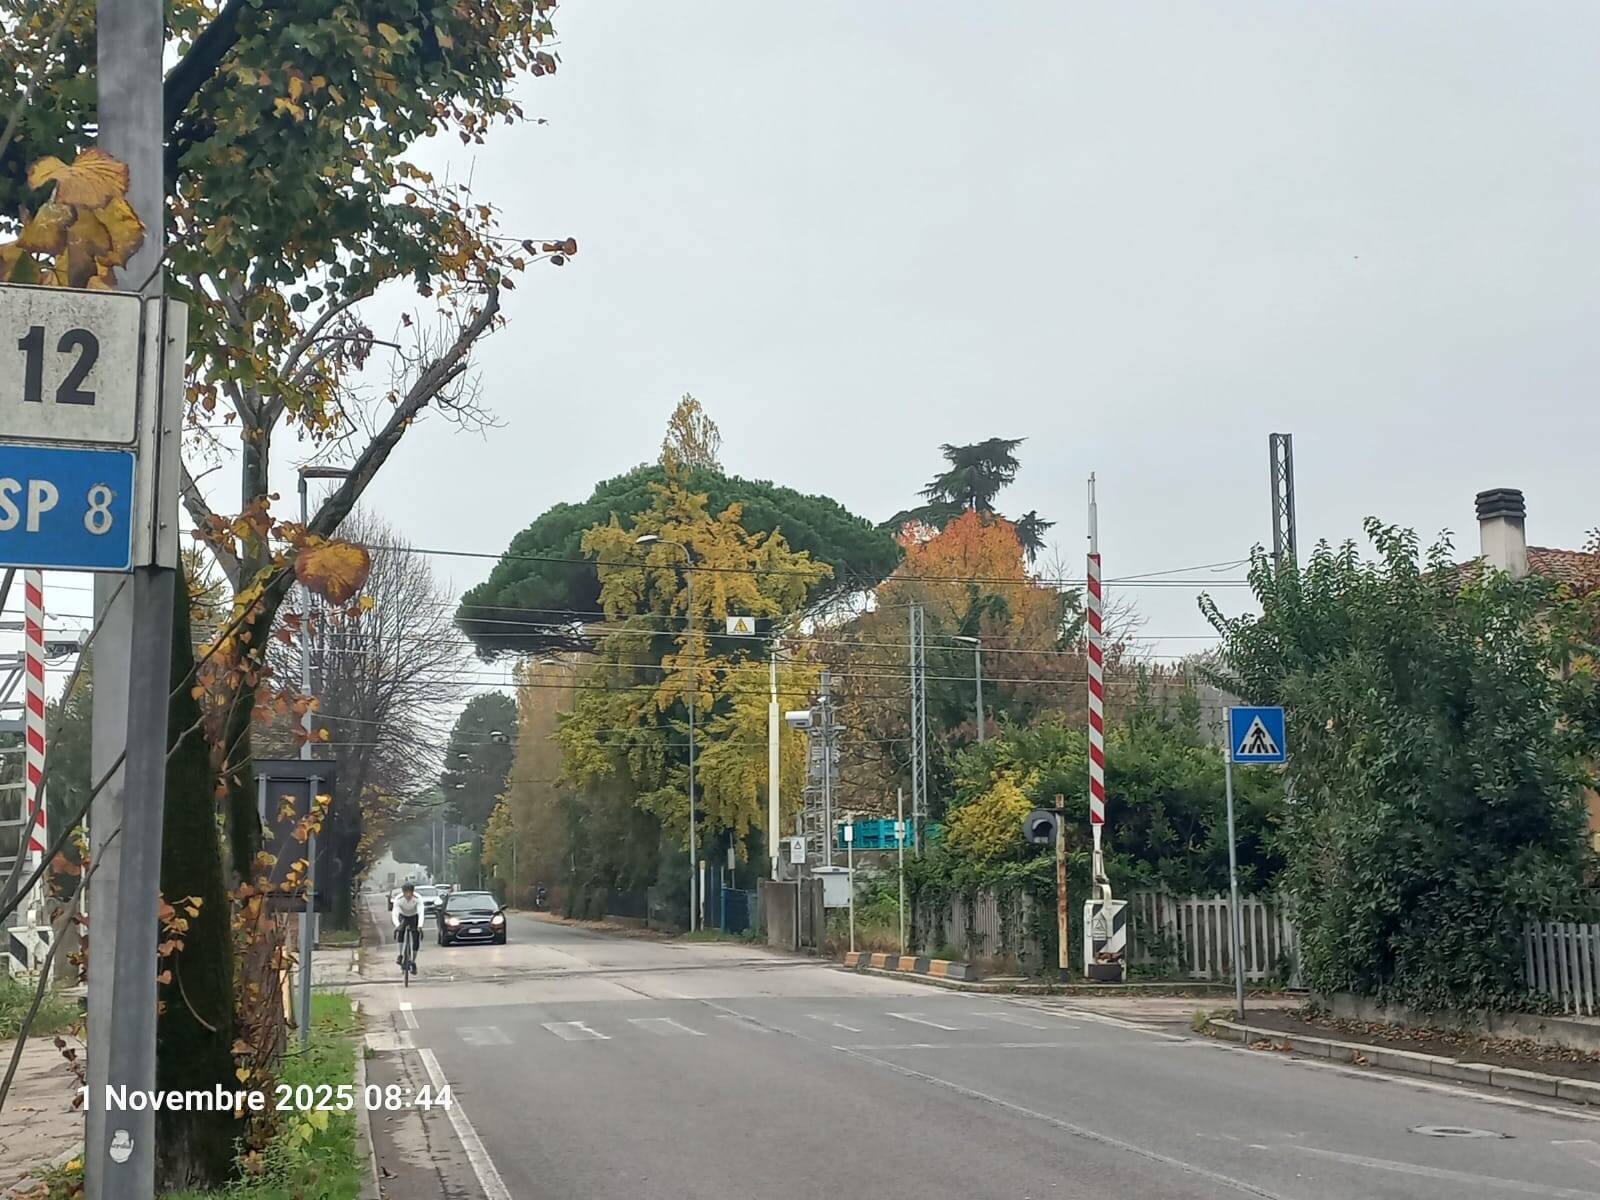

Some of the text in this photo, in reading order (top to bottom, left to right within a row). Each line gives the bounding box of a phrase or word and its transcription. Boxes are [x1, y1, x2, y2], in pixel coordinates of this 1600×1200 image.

[18, 326, 99, 405] 12
[0, 478, 113, 535] SP 8
